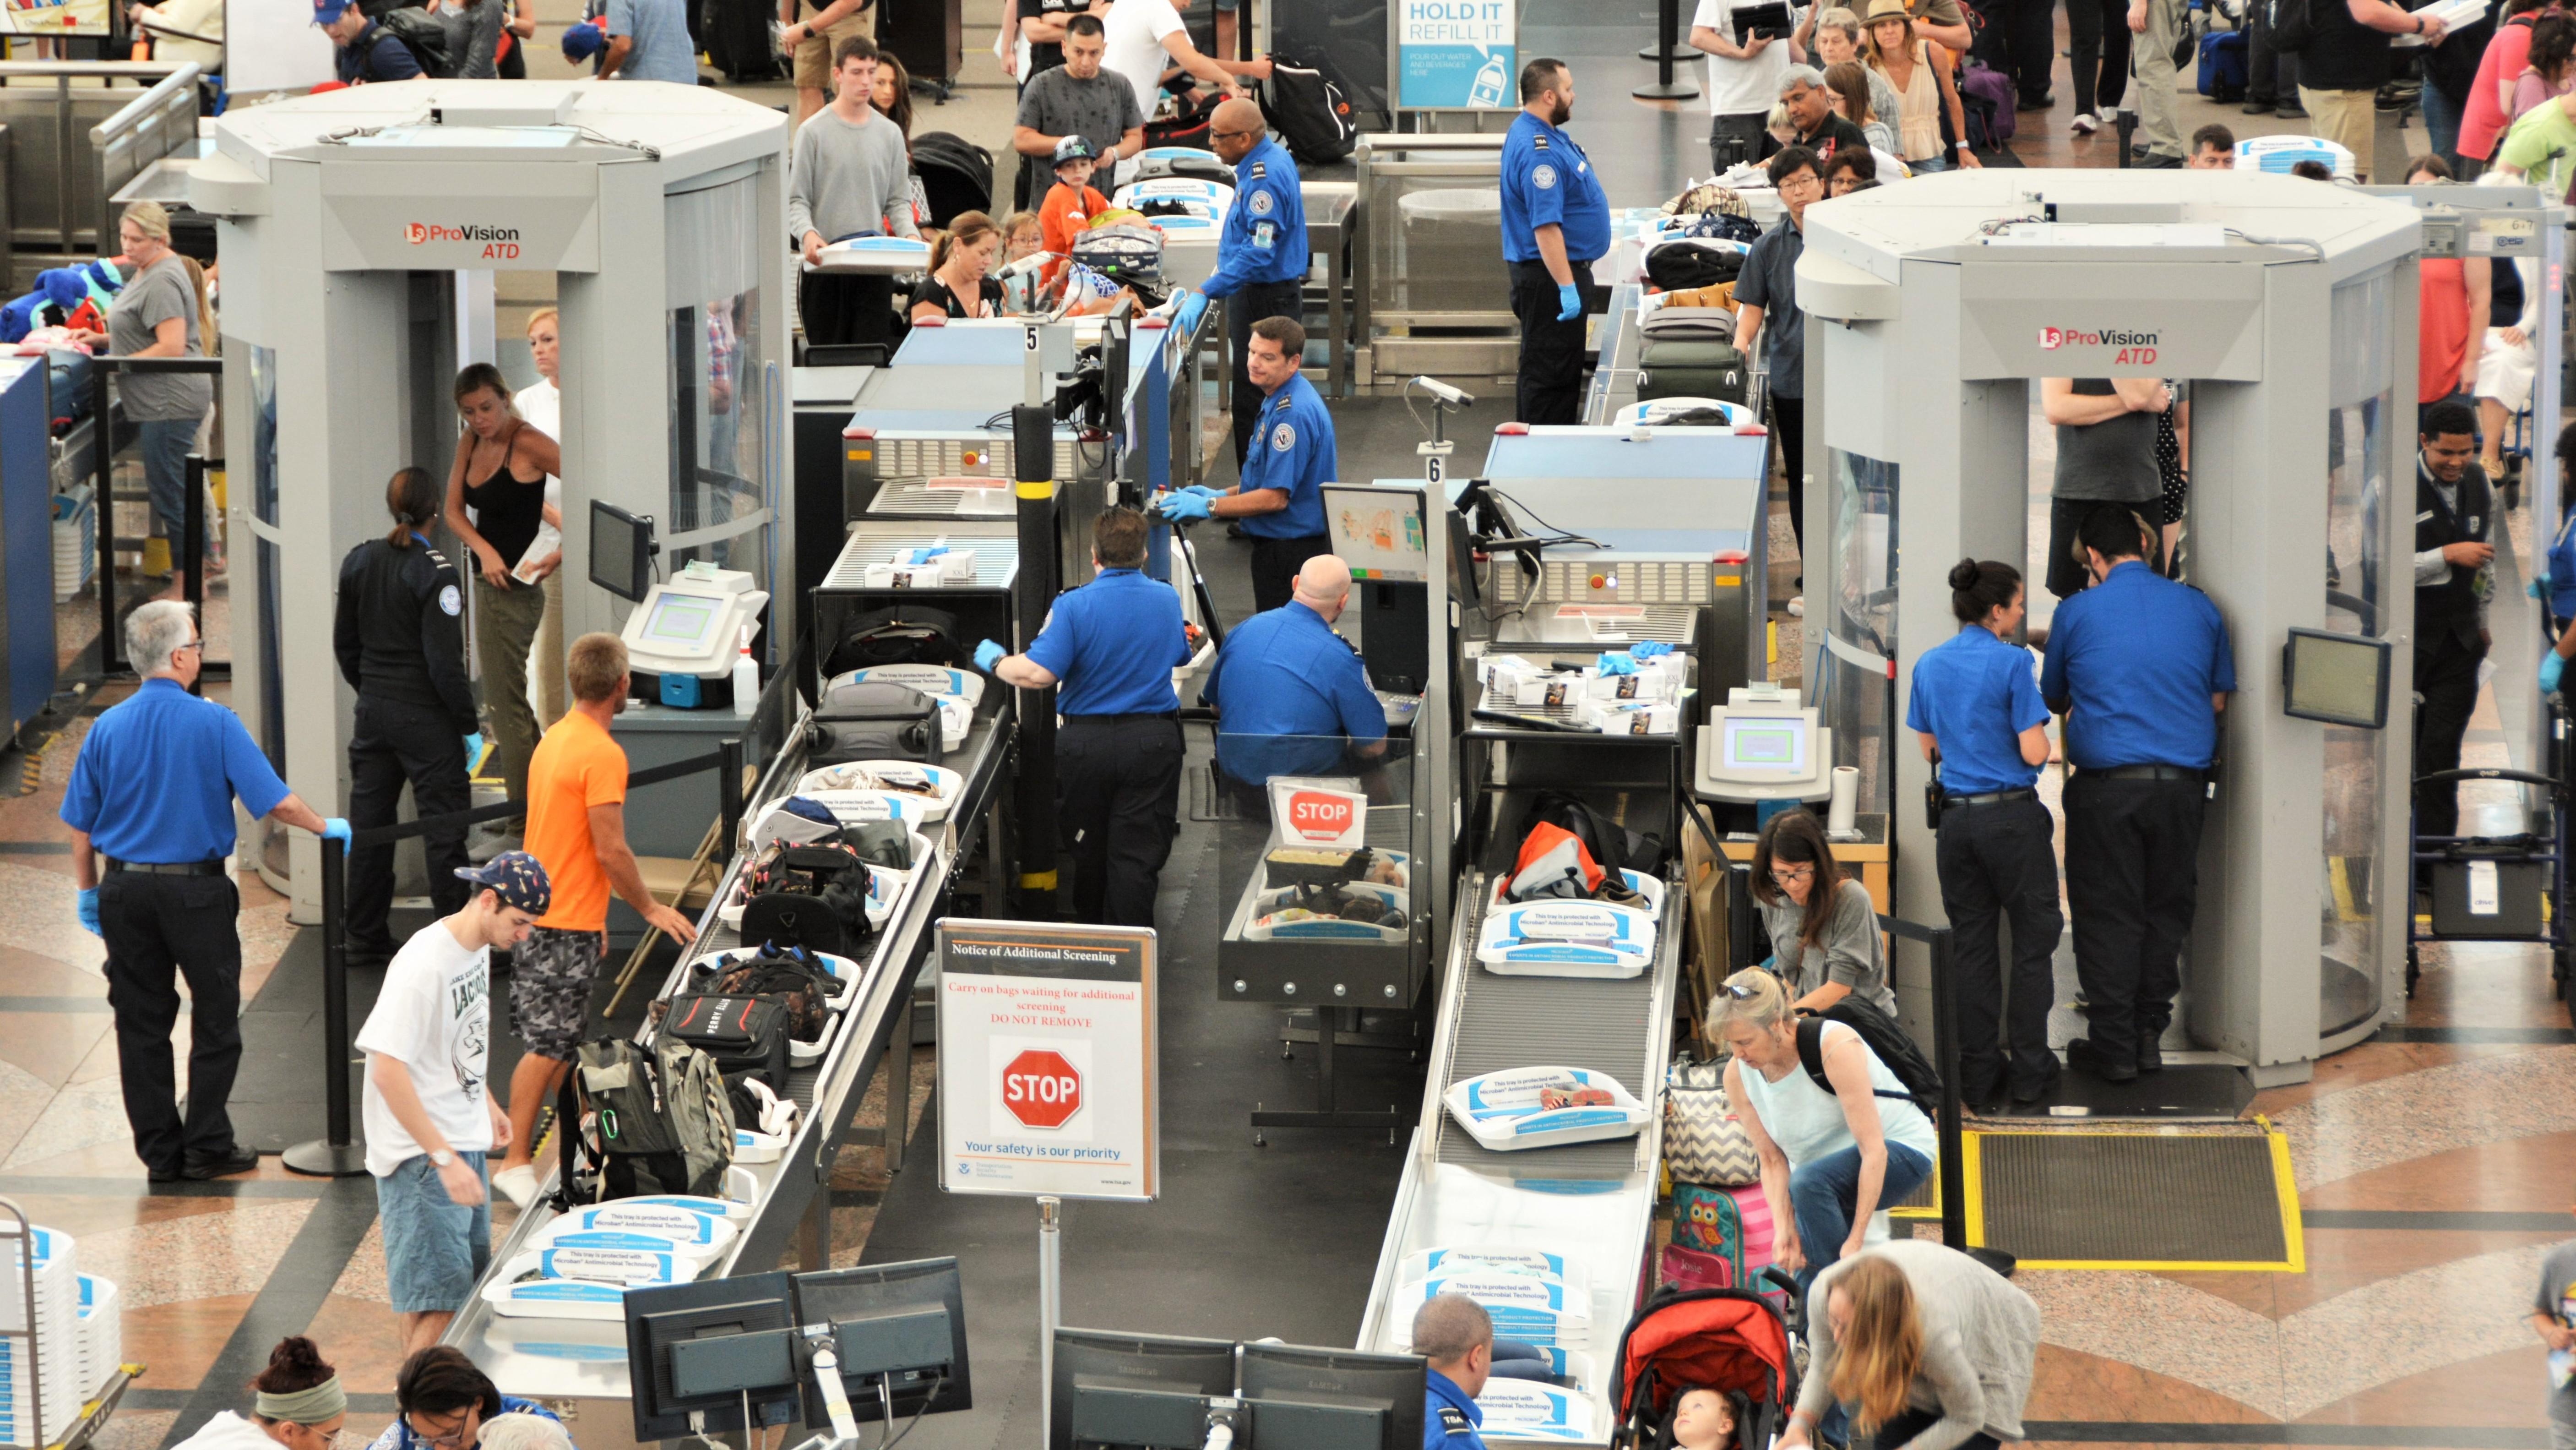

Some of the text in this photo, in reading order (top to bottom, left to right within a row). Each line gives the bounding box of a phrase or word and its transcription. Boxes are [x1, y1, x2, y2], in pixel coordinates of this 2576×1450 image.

[1410, 3, 1502, 20] HOLD IT
[1410, 24, 1503, 39] REFILL IT
[429, 225, 519, 240] ProVision
[482, 244, 520, 259] ATD
[1027, 327, 1037, 350] 5
[2115, 348, 2157, 364] ATD
[1429, 458, 1440, 482] 6
[1297, 802, 1347, 820] STOP
[952, 944, 1116, 965] Notice of Additional Screening
[949, 982, 1135, 1001] Carry on bags waiting for additional
[1017, 1002, 1065, 1014] screening
[990, 1014, 1092, 1028] DO NOT REMOVE
[1007, 1073, 1076, 1103] STOP
[965, 1141, 1120, 1160] Your safety is our priority
[1681, 1258, 1702, 1274] Josie
